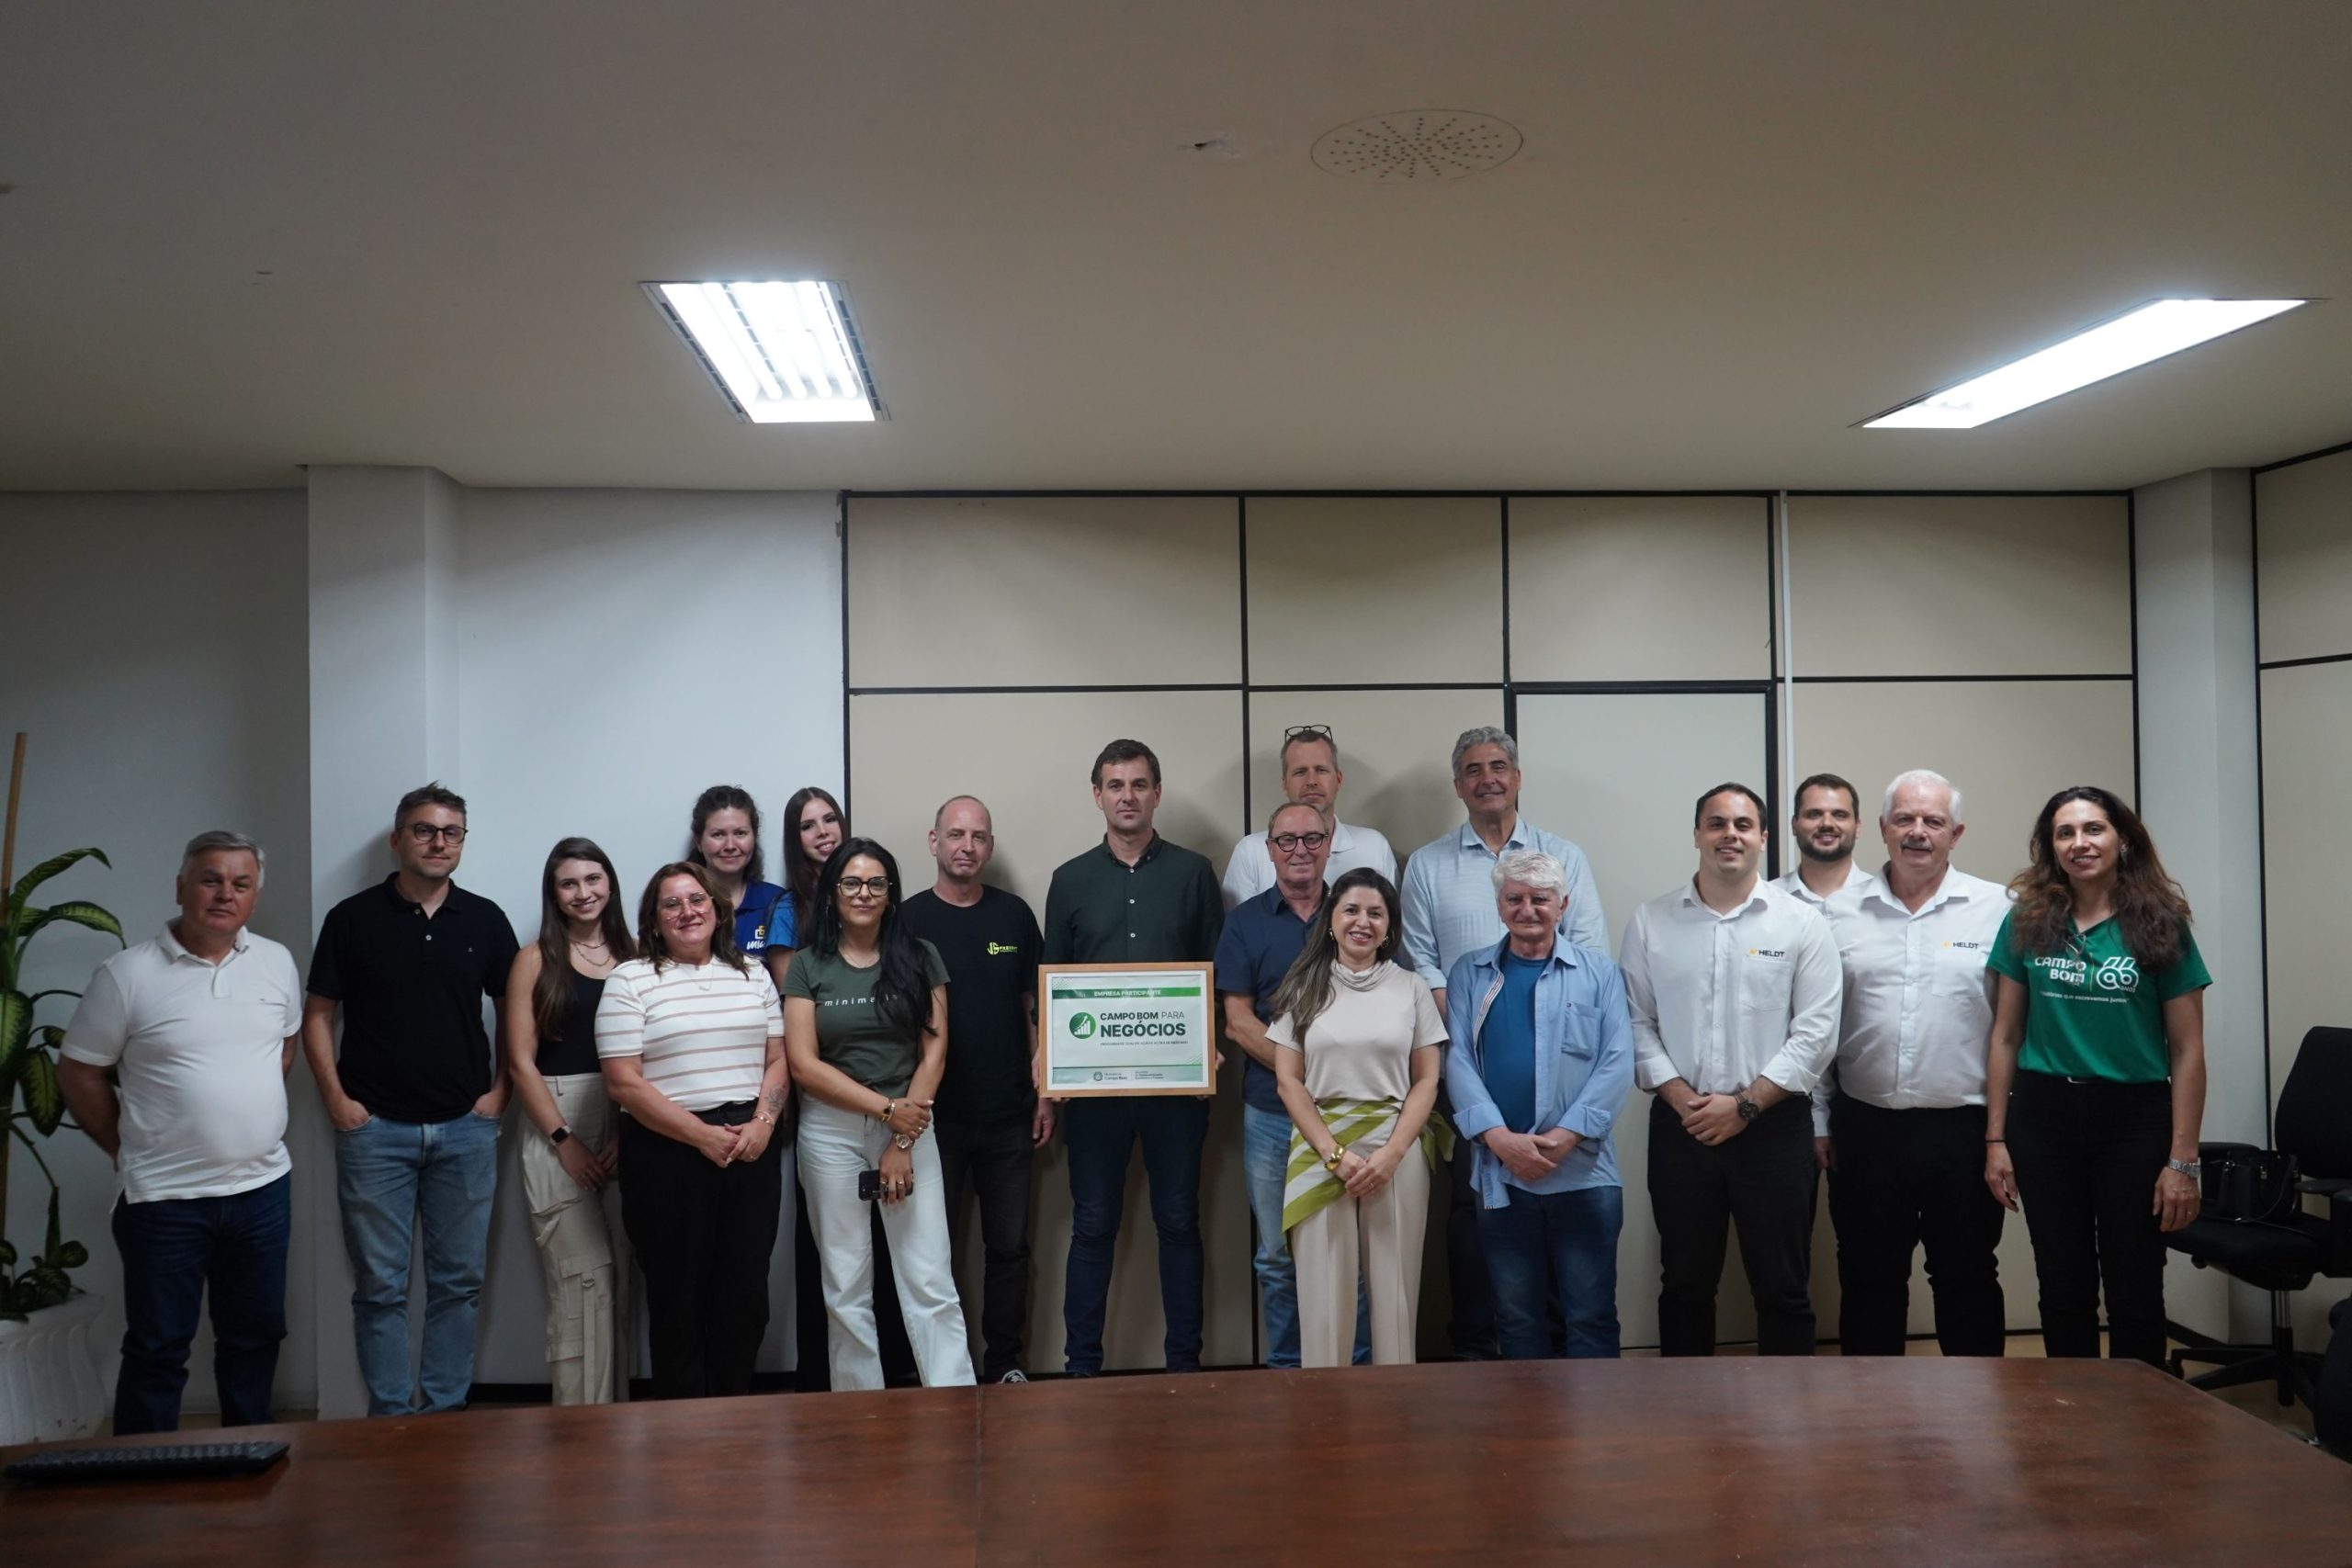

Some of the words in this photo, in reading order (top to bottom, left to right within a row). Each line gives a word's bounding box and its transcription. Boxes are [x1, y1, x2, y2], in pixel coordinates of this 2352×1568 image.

[1952, 942, 1979, 950] HELDT
[1758, 949, 1785, 958] HELDT
[2034, 956, 2087, 971] CAMPO
[1100, 1012, 1136, 1021] CAMPO
[1136, 1011, 1159, 1020] BOM
[1100, 1021, 1186, 1038] NEGÓCIOS
